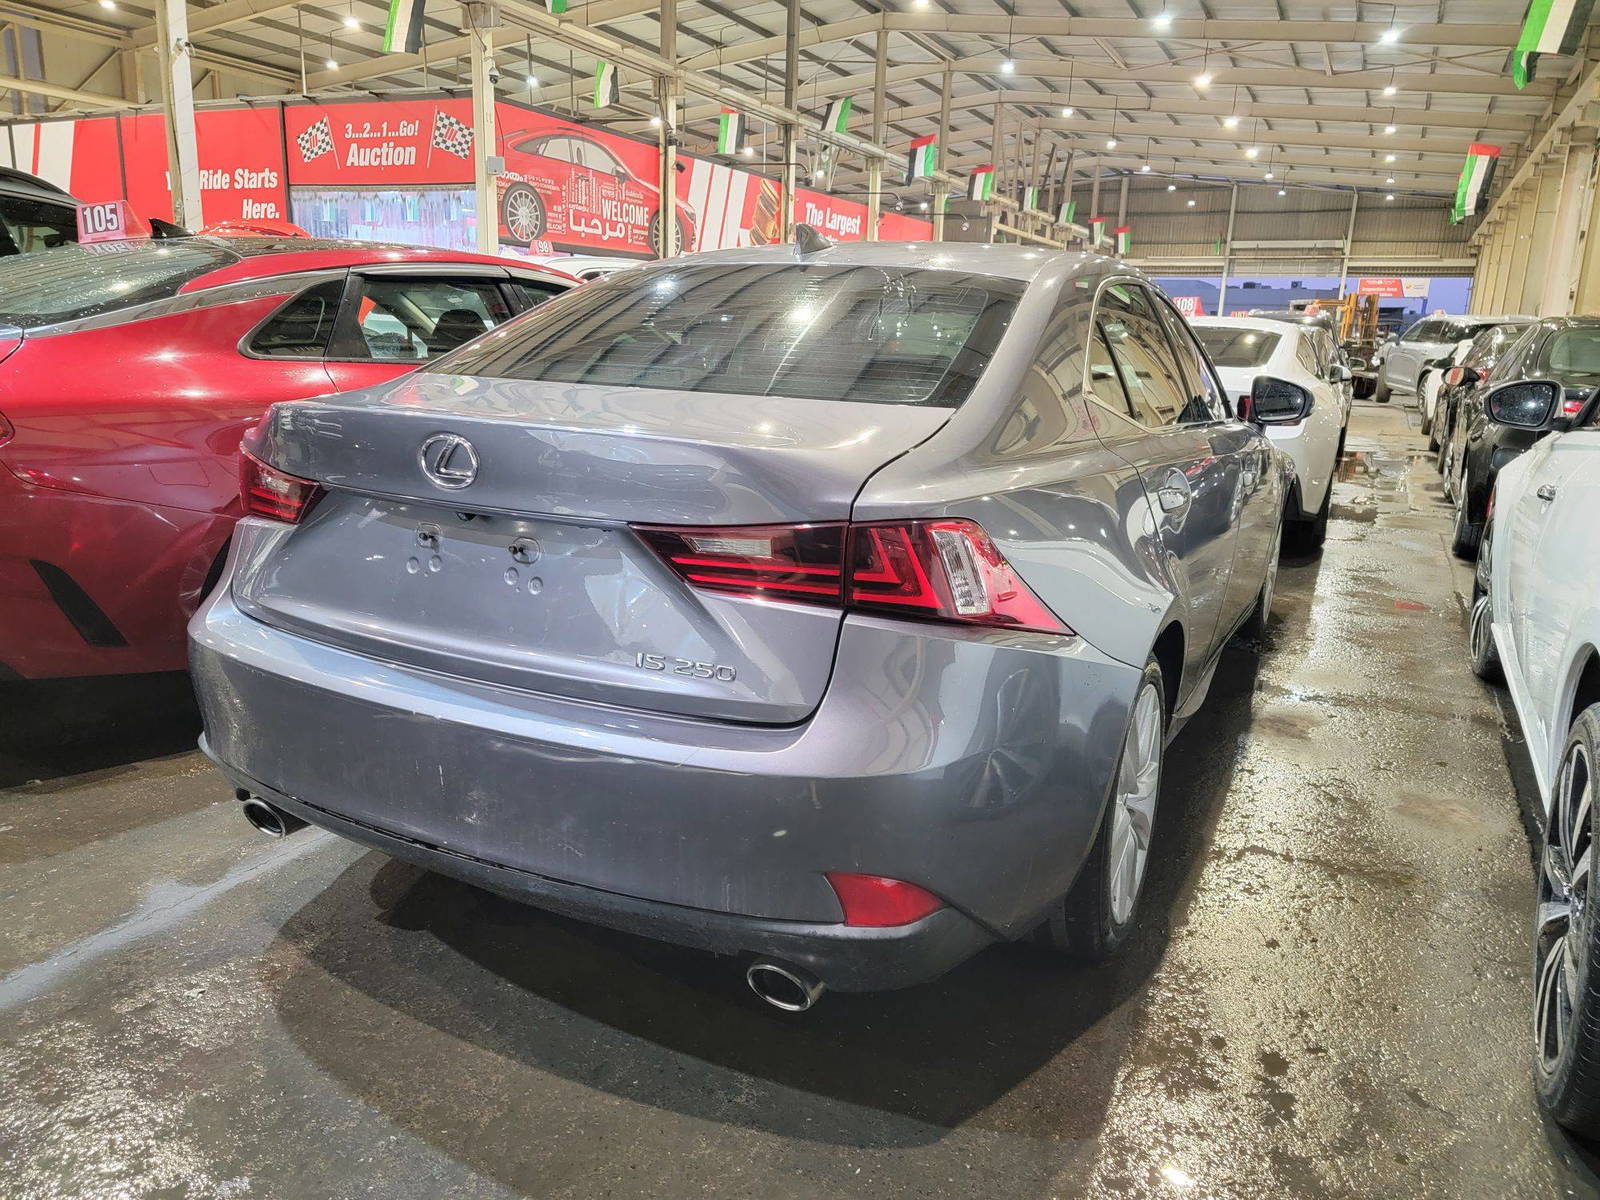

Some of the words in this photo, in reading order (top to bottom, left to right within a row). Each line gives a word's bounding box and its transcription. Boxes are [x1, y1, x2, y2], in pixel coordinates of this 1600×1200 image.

[346, 141, 416, 167] Auction
[199, 168, 231, 190] Ride
[233, 168, 278, 190] Starts
[83, 203, 118, 234] 105
[242, 198, 280, 219] Here.
[602, 198, 649, 227] WELCOME
[805, 201, 824, 227] The
[825, 207, 861, 237] Largest
[568, 208, 626, 241] مرحبا
[1176, 297, 1194, 311] 108
[635, 651, 666, 672] IS
[673, 657, 737, 682] 250
